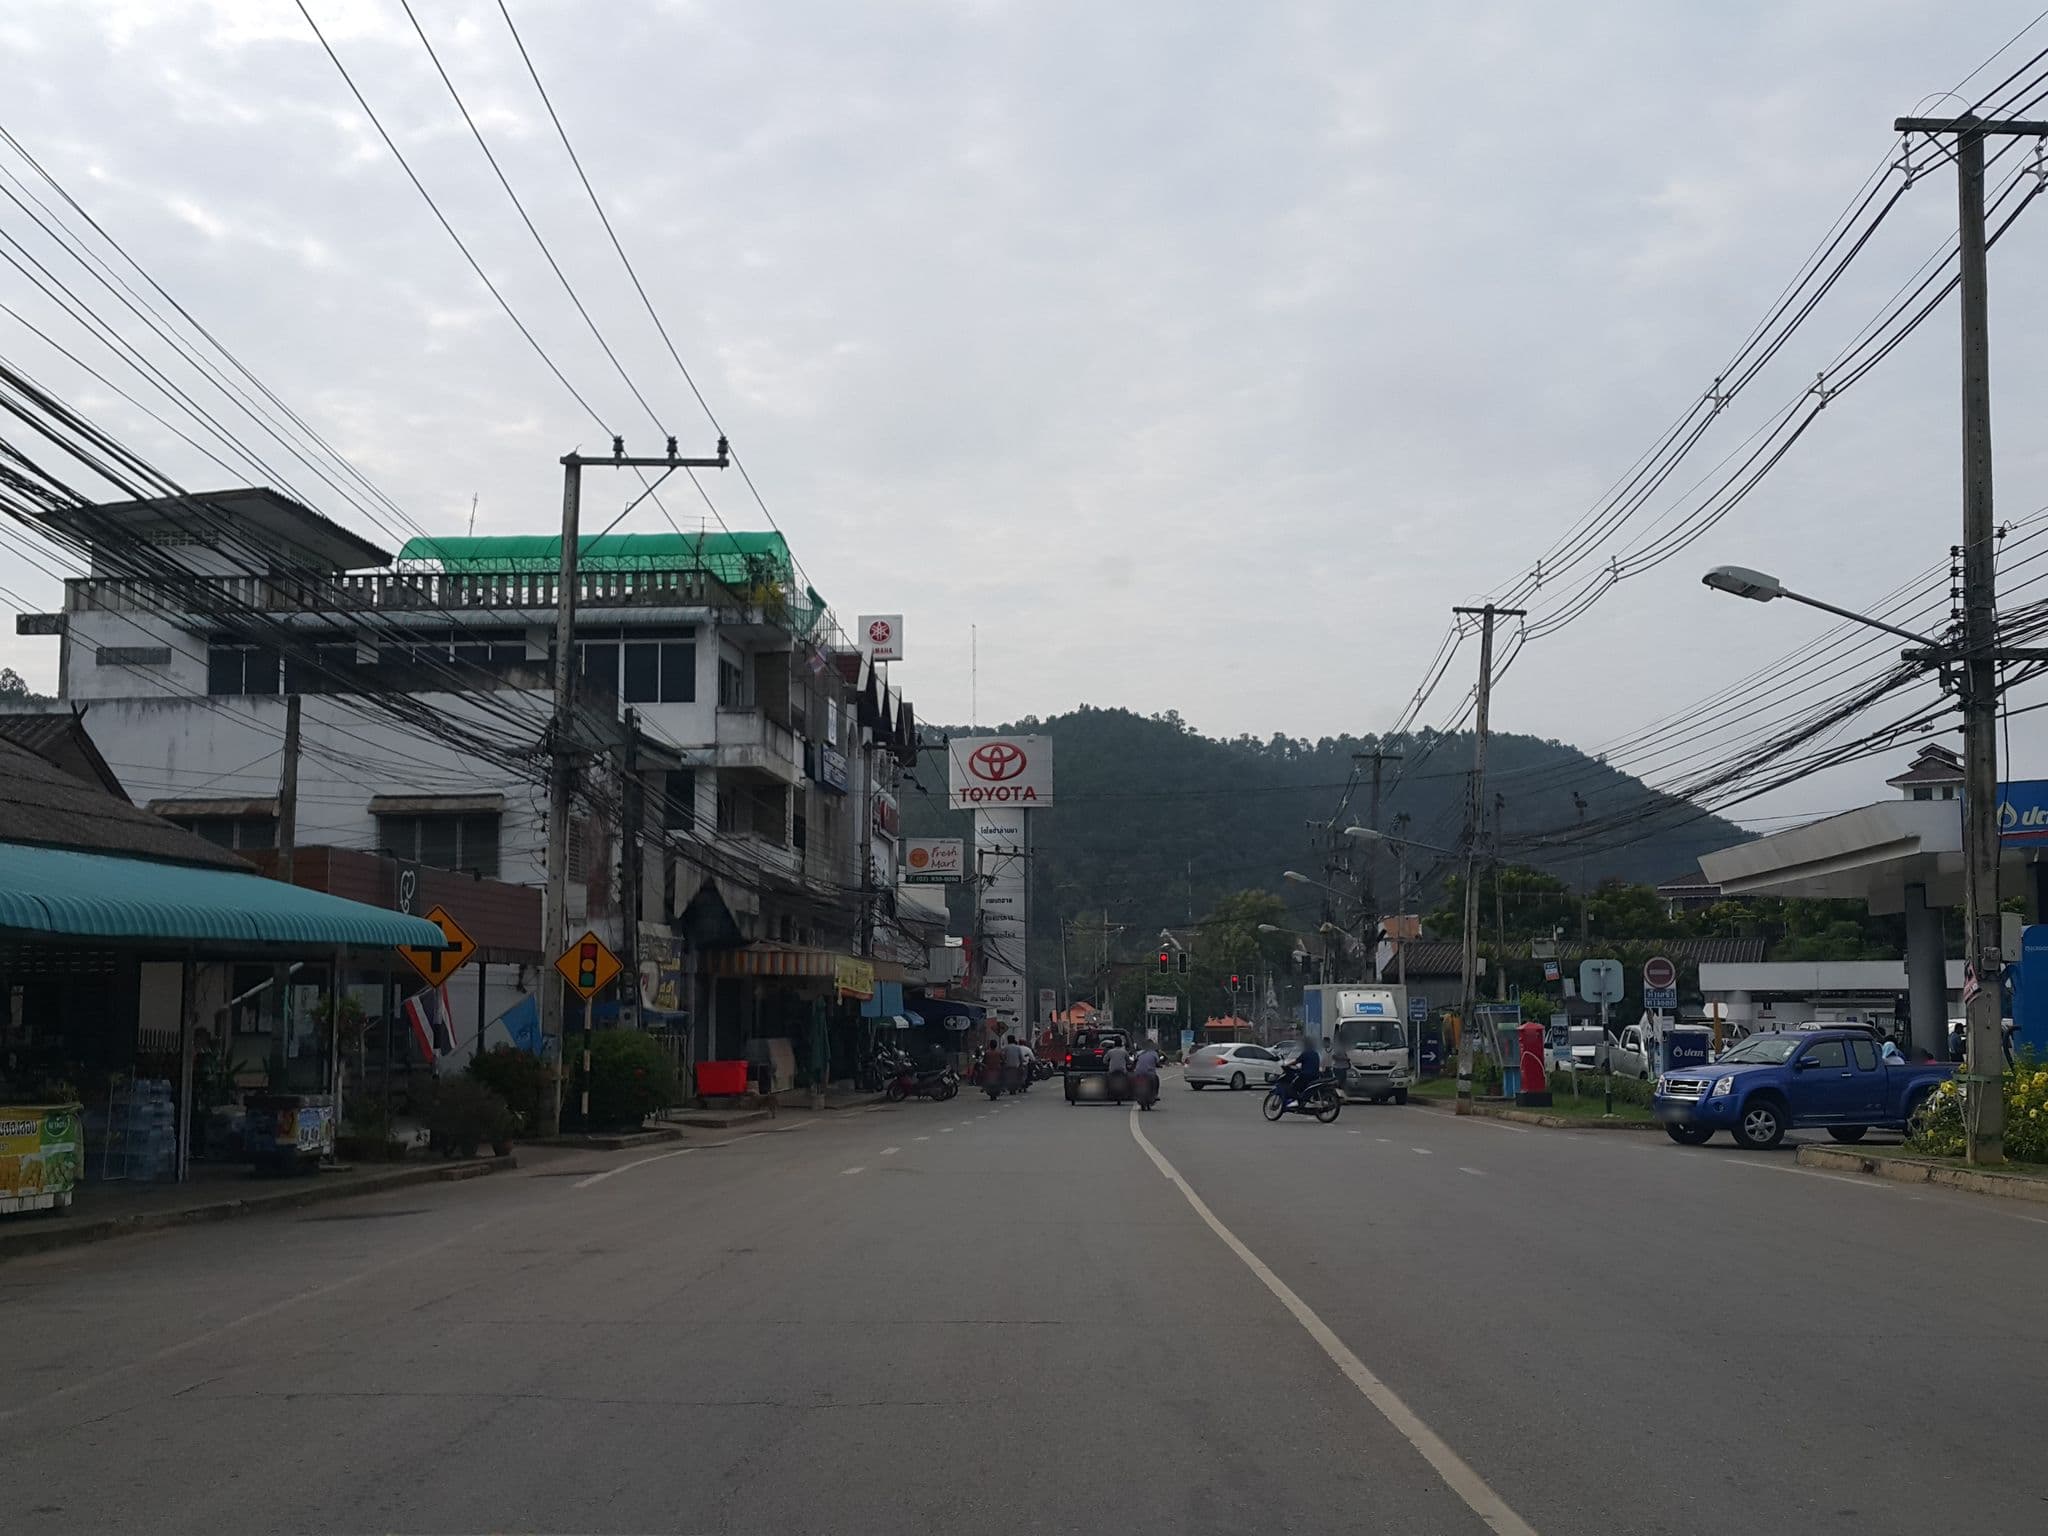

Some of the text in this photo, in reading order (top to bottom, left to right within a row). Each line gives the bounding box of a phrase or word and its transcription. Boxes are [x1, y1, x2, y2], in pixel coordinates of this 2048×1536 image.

[960, 786, 1037, 802] TOYOTA
[931, 846, 957, 858] Fresh
[931, 859, 957, 869] Mart
